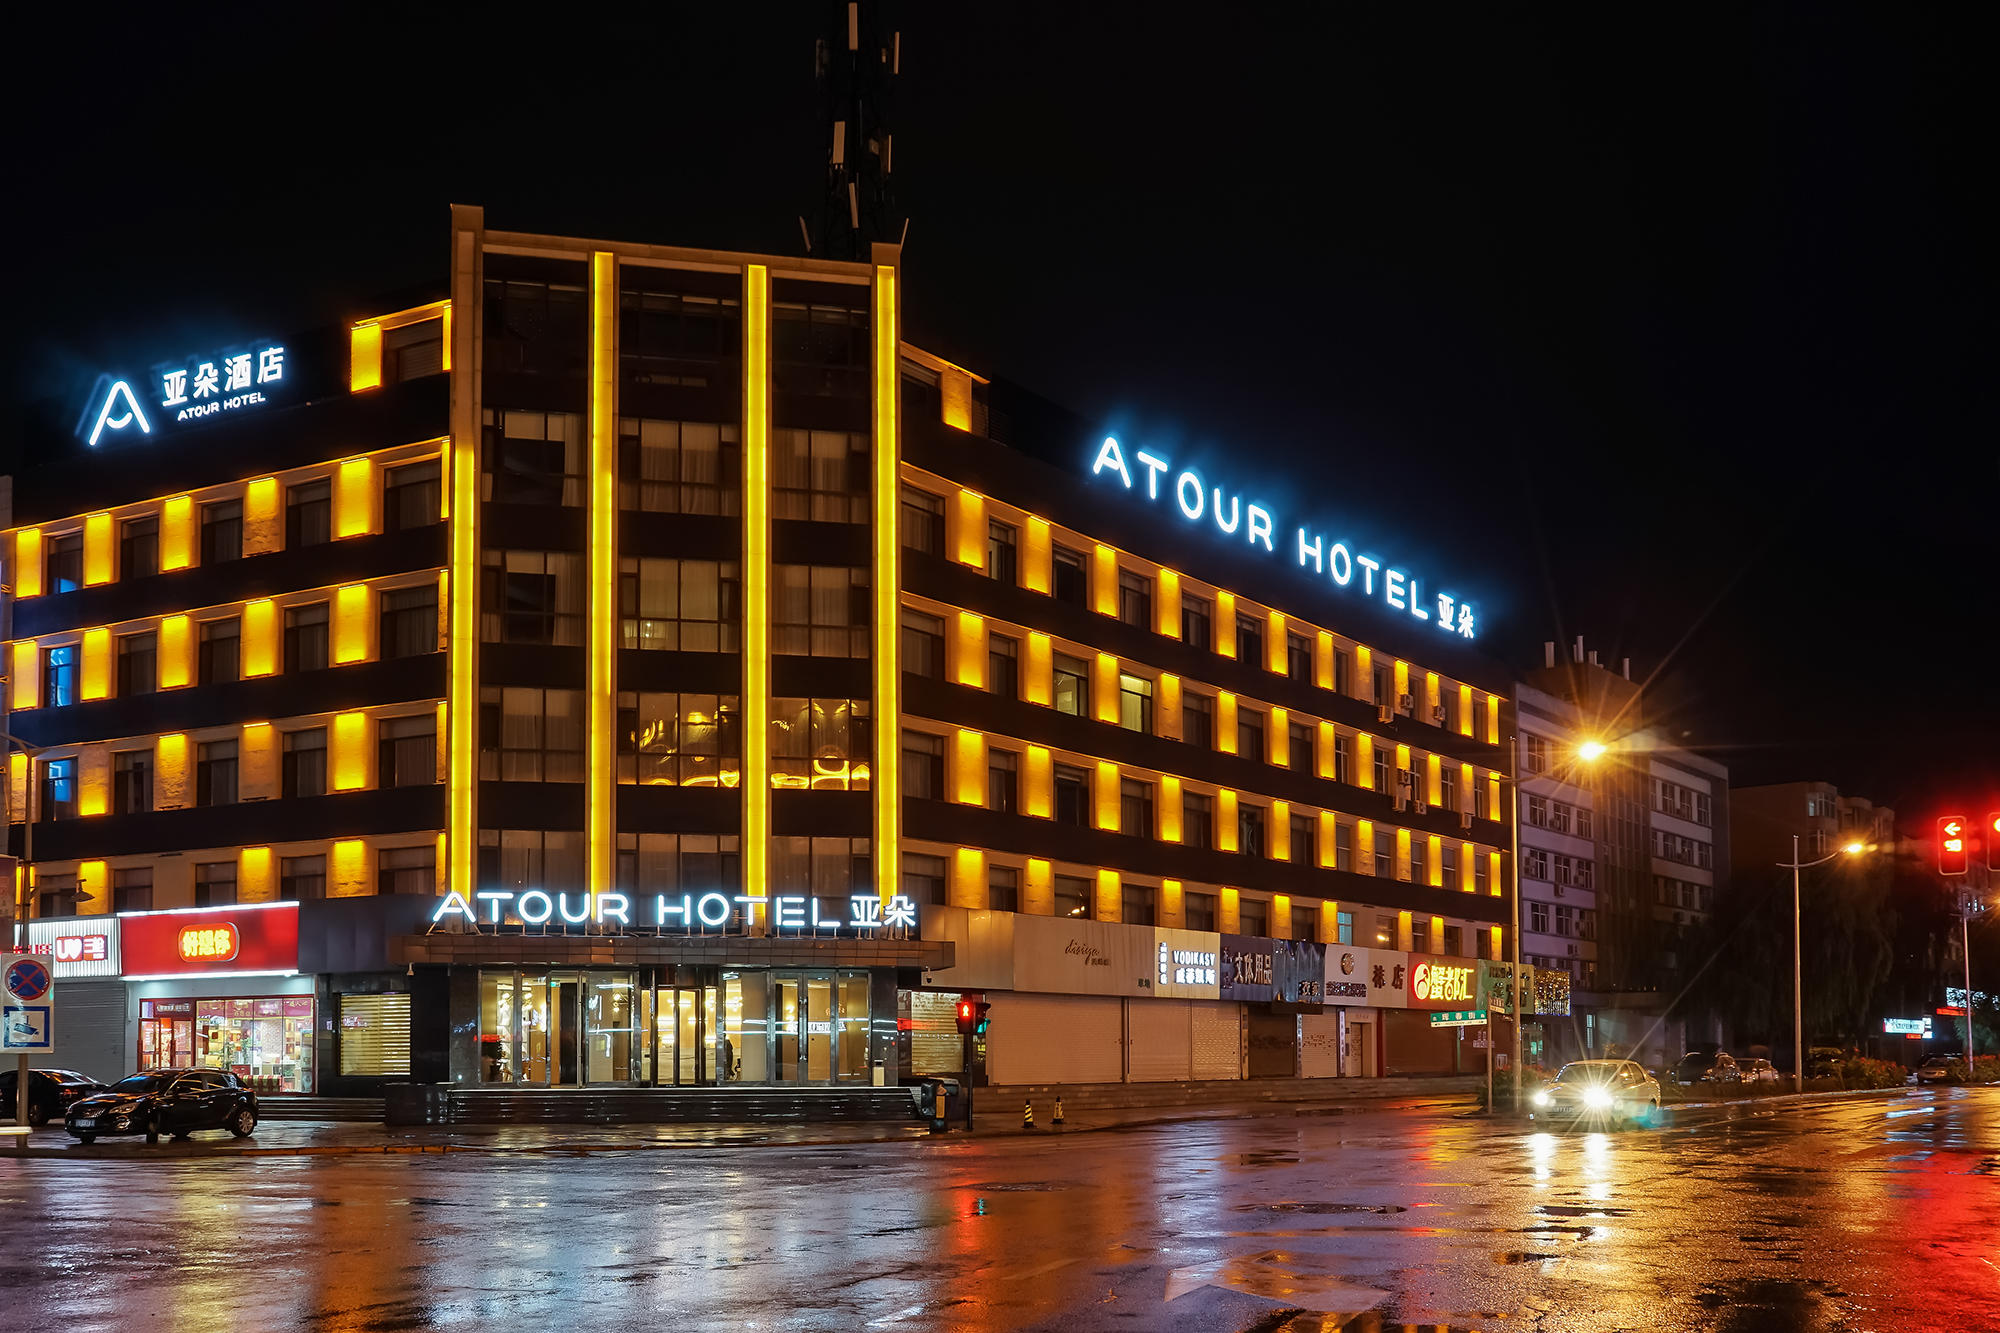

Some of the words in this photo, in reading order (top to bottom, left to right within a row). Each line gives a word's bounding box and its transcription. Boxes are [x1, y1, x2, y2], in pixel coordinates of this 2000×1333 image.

[162, 347, 284, 407] 亚朵酒店
[177, 402, 220, 421] ATOUR
[223, 392, 266, 410] HOTEL
[1092, 436, 1274, 552] ATOUR
[1297, 527, 1429, 621] HOTEL
[1437, 592, 1475, 640] 亚朵
[432, 890, 630, 925] ATOUR
[657, 892, 841, 928] HOTEL
[849, 895, 917, 928] 亚朵
[182, 929, 231, 957] 好想你
[1172, 950, 1216, 967] VODIKASY
[1233, 951, 1272, 985] 文体用品
[1430, 965, 1475, 1001] 蟹都汇
